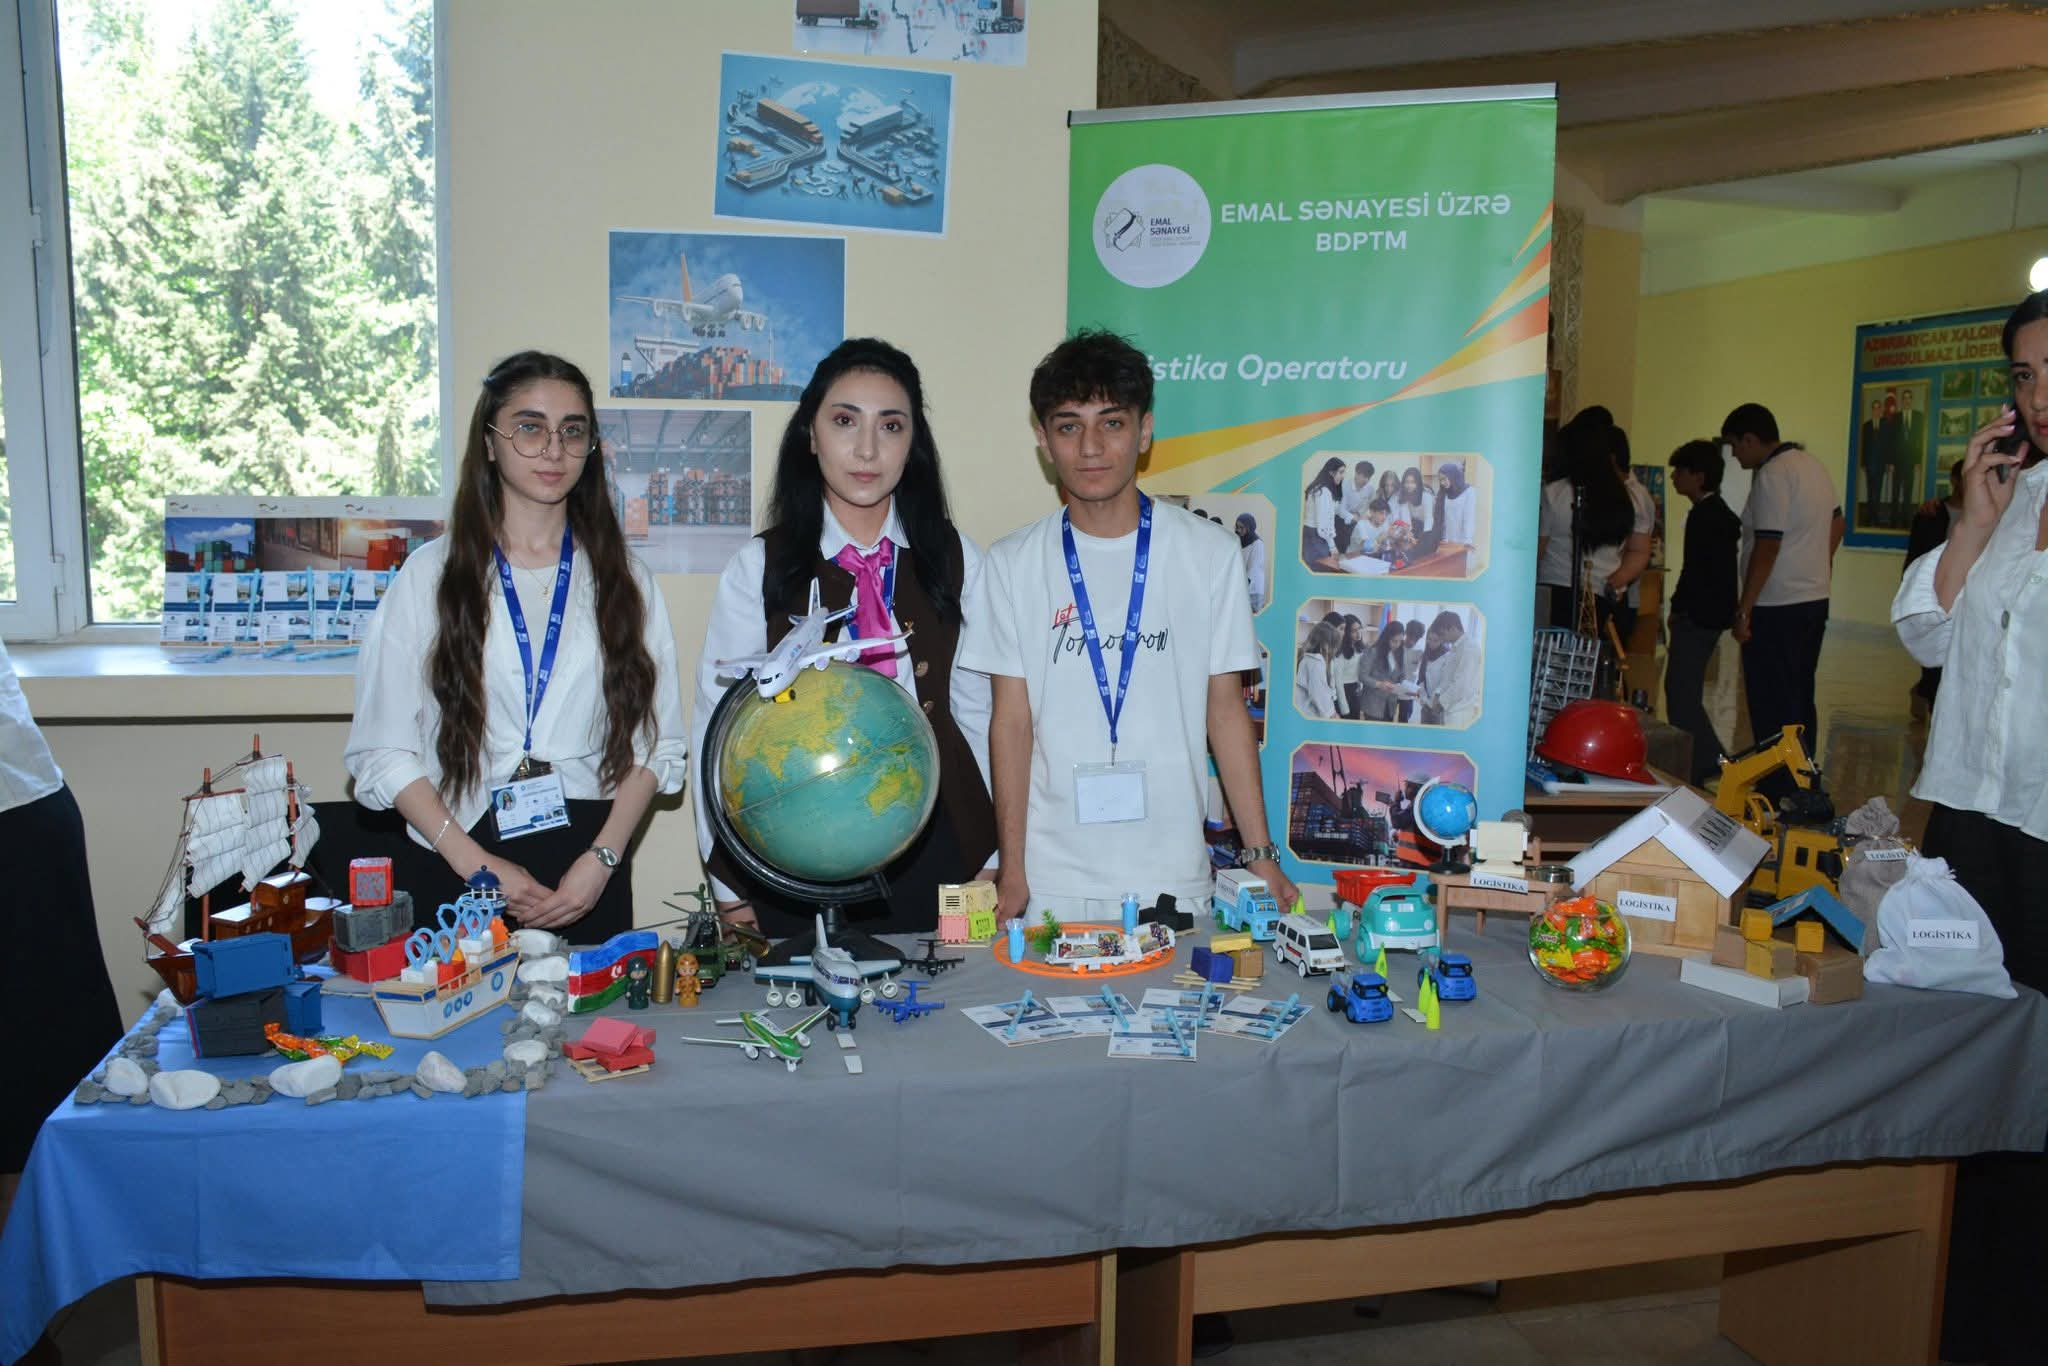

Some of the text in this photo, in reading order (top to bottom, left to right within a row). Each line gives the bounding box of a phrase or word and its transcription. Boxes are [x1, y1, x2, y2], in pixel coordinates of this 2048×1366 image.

[1220, 192, 1512, 223] EMAL SƏNAYESİ ÜZRƏ
[1150, 217, 1171, 227] EMAL
[1315, 230, 1408, 252] BDPTM
[1147, 353, 1409, 387] istika Operatoru
[1619, 899, 1671, 912] LOGİSTİKA
[1912, 929, 1975, 940] LOGİSTİKA
